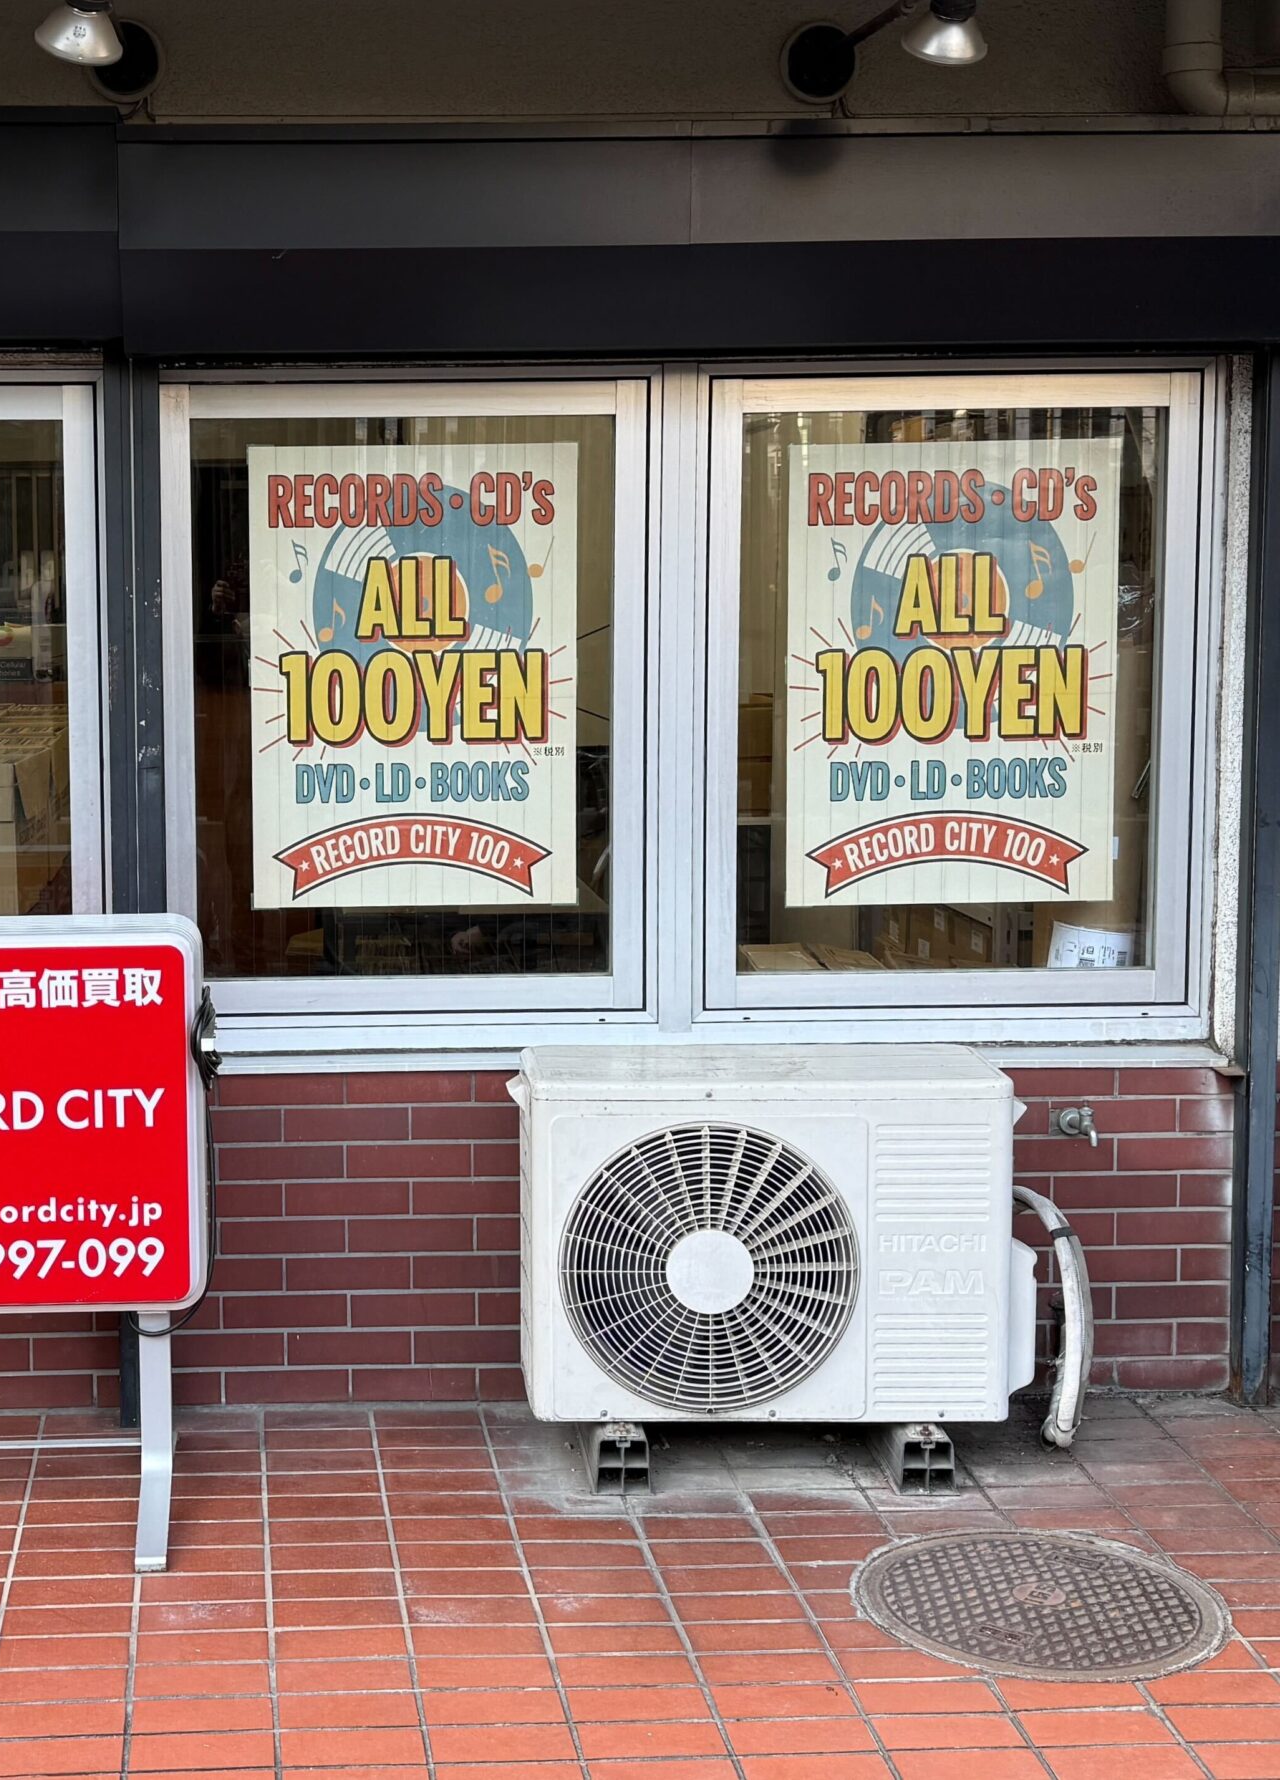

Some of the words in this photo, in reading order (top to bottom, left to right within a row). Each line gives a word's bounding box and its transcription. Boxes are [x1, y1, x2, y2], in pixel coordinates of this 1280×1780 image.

[267, 472, 443, 529] RECORDS
[469, 471, 556, 526] CD's
[807, 469, 985, 527] RECORDS
[1011, 467, 1097, 522] CD's
[355, 556, 469, 643] ALL
[893, 552, 1008, 640] ALL
[279, 649, 549, 747] 100YEN
[815, 645, 1088, 745] 100YEN
[296, 763, 355, 804] DVD
[375, 762, 411, 803] LD
[430, 760, 530, 803] BOOKS
[829, 761, 890, 802] DVD
[910, 760, 946, 801] LD
[967, 757, 1068, 800] BOOKS
[310, 825, 401, 874] RECORD
[409, 824, 463, 856] CITY
[468, 832, 511, 870] 100
[842, 822, 935, 872] RECORD
[944, 821, 998, 854] CITY
[1004, 829, 1047, 867] 100
[56, 1087, 165, 1131] CITY
[879, 1233, 987, 1253] HITACHI
[878, 1268, 985, 1296] PAM
